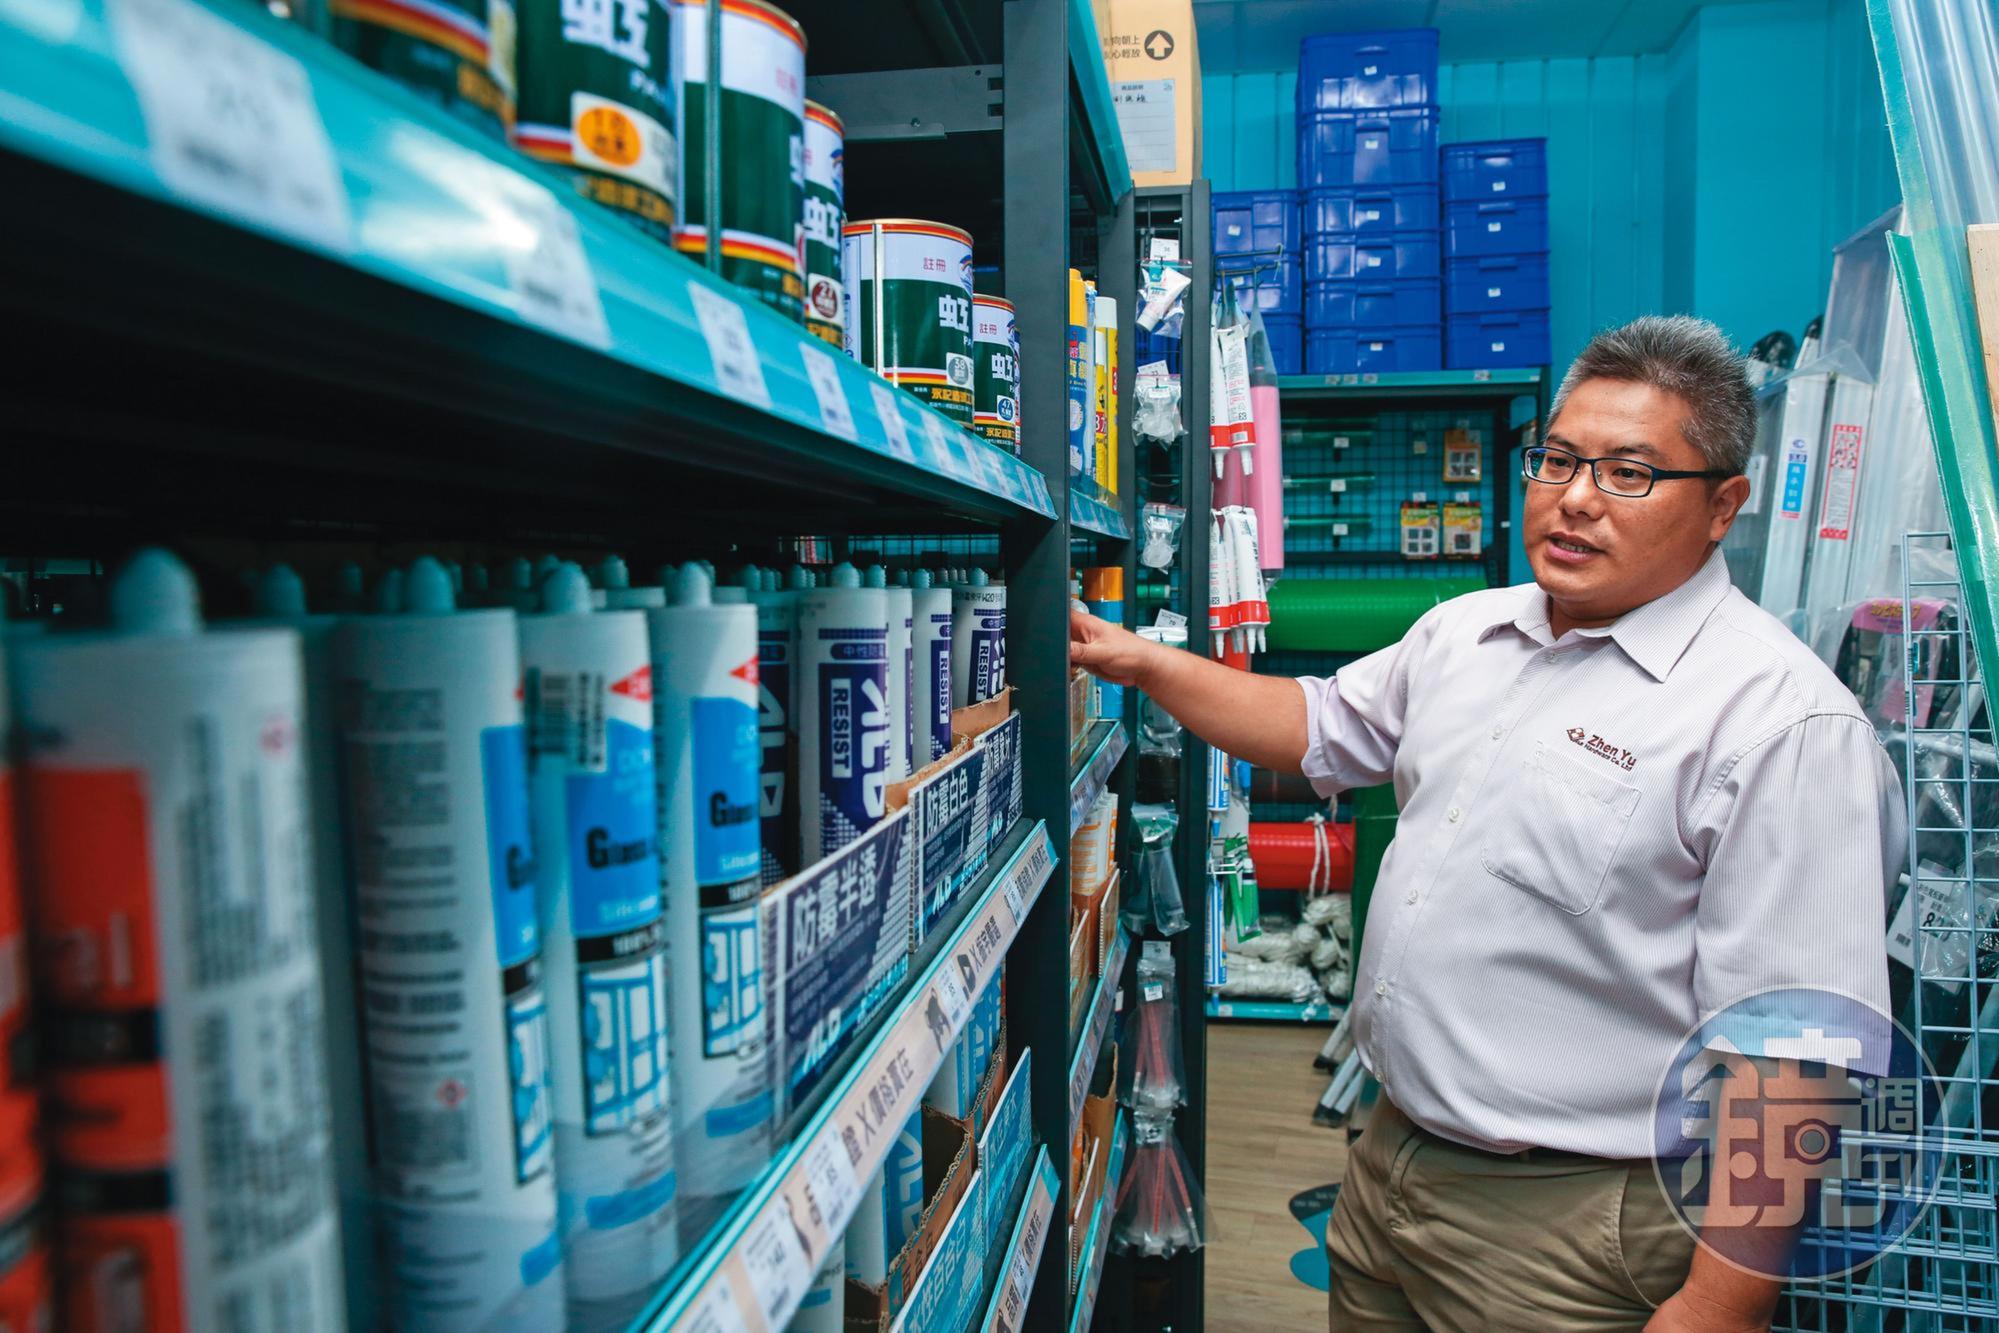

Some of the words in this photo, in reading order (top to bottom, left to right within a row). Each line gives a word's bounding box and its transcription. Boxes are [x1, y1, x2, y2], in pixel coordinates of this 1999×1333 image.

[923, 257, 946, 273] 註冊
[979, 323, 998, 335] 註冊
[954, 358, 966, 370] 38
[940, 657, 949, 717] RESIST
[977, 646, 989, 696] RESIST
[833, 688, 850, 770] RESIST
[1587, 734, 1619, 757] Zhen
[1620, 749, 1637, 766] Yu
[926, 767, 969, 838] 防霉白色
[793, 841, 878, 968] 防霉半透
[868, 1047, 914, 1126] 價格實在
